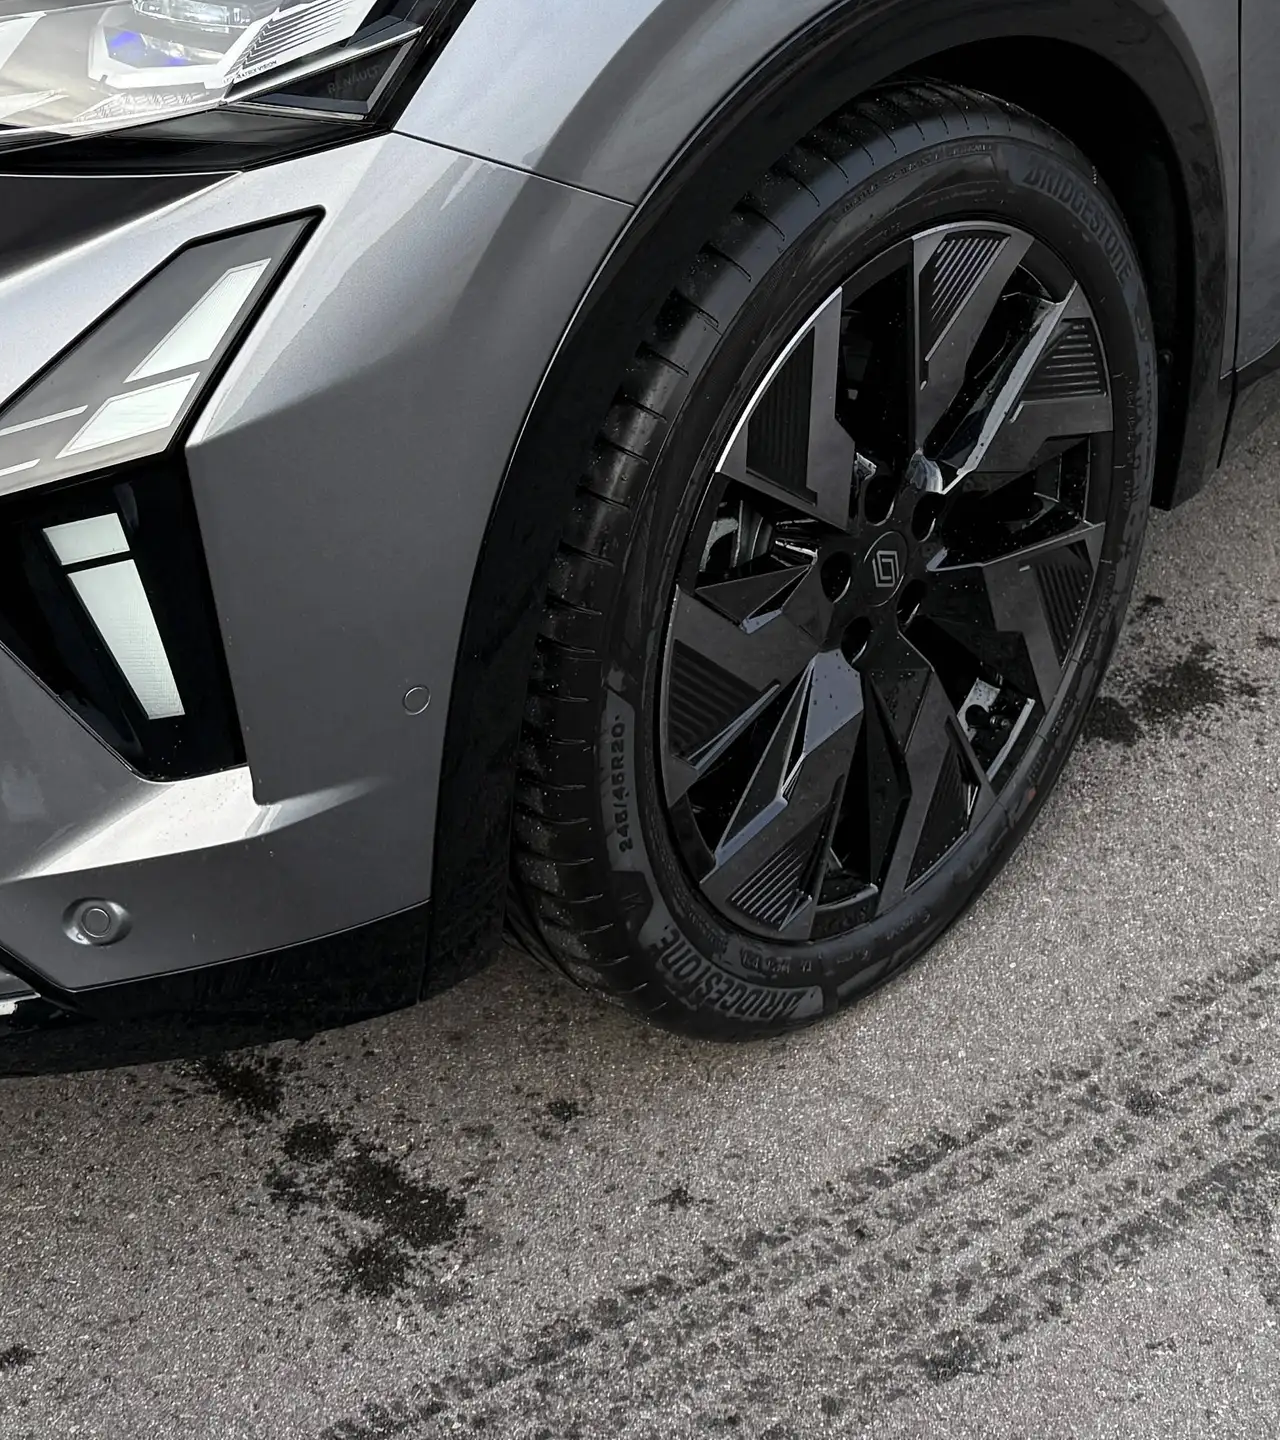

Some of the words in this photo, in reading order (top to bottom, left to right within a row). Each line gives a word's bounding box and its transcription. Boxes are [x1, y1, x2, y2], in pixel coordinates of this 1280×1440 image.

[236, 68, 257, 80] MATRIX
[257, 59, 277, 71] VISION
[327, 64, 380, 94] RENAULT
[1022, 154, 1132, 284] BRIDGESTONE
[610, 722, 634, 854] 245/45R20
[648, 924, 806, 1022] BRIDGESTONE
